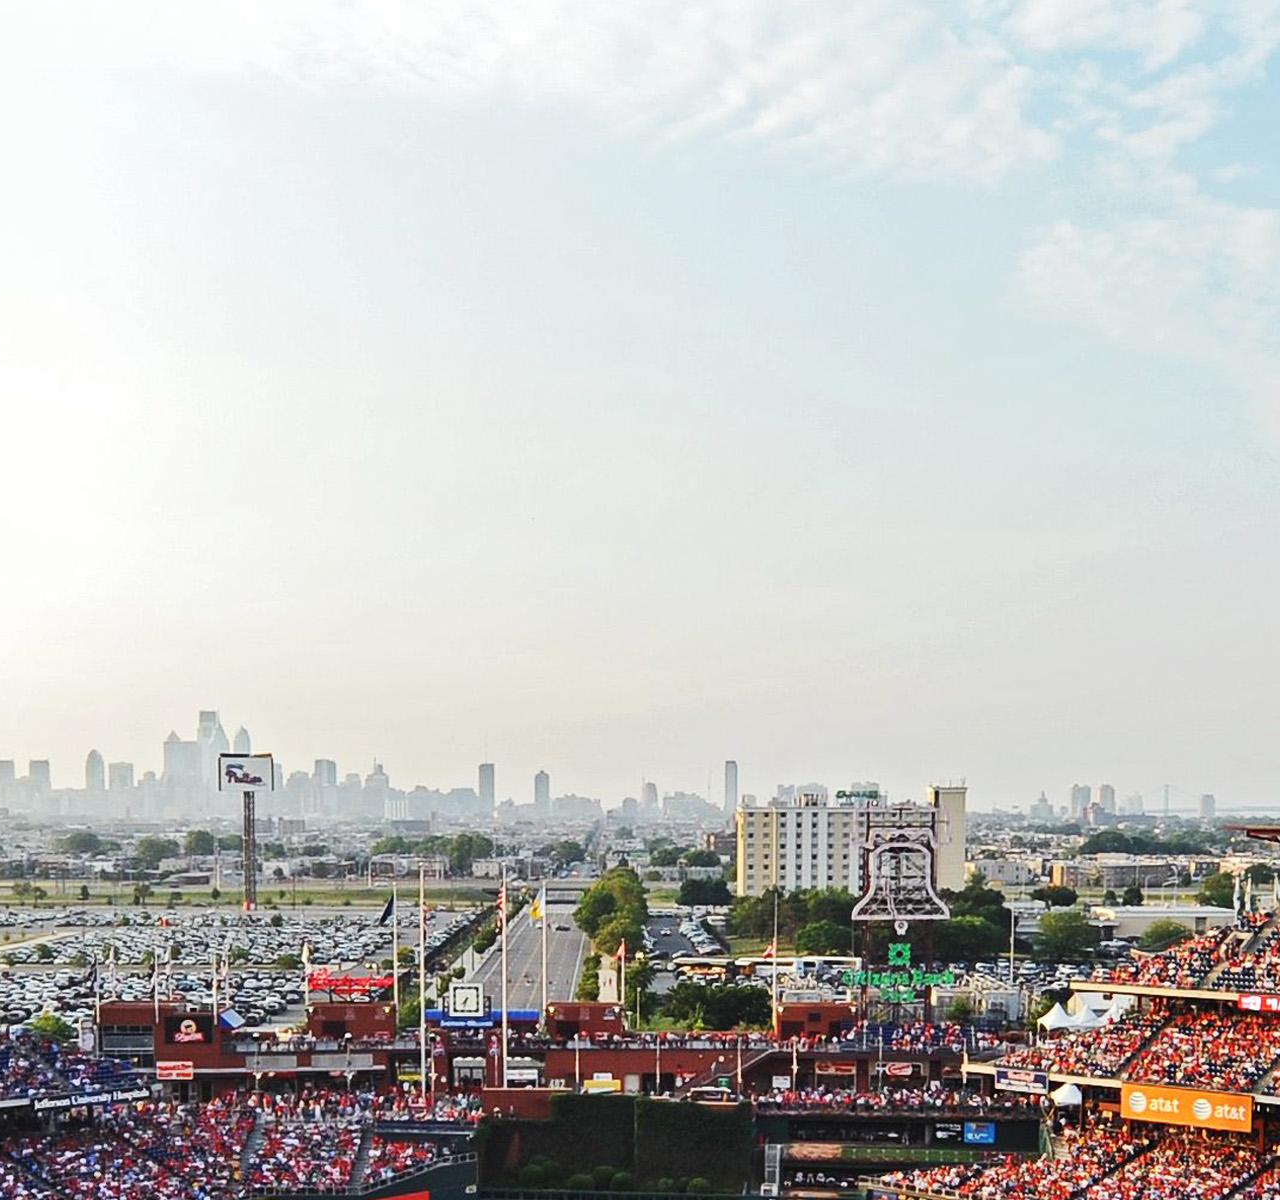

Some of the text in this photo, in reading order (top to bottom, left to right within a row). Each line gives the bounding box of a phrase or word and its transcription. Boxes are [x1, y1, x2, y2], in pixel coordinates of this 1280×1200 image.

[842, 969, 909, 986] Citizens
[1150, 1098, 1246, 1121] at&t at&t
